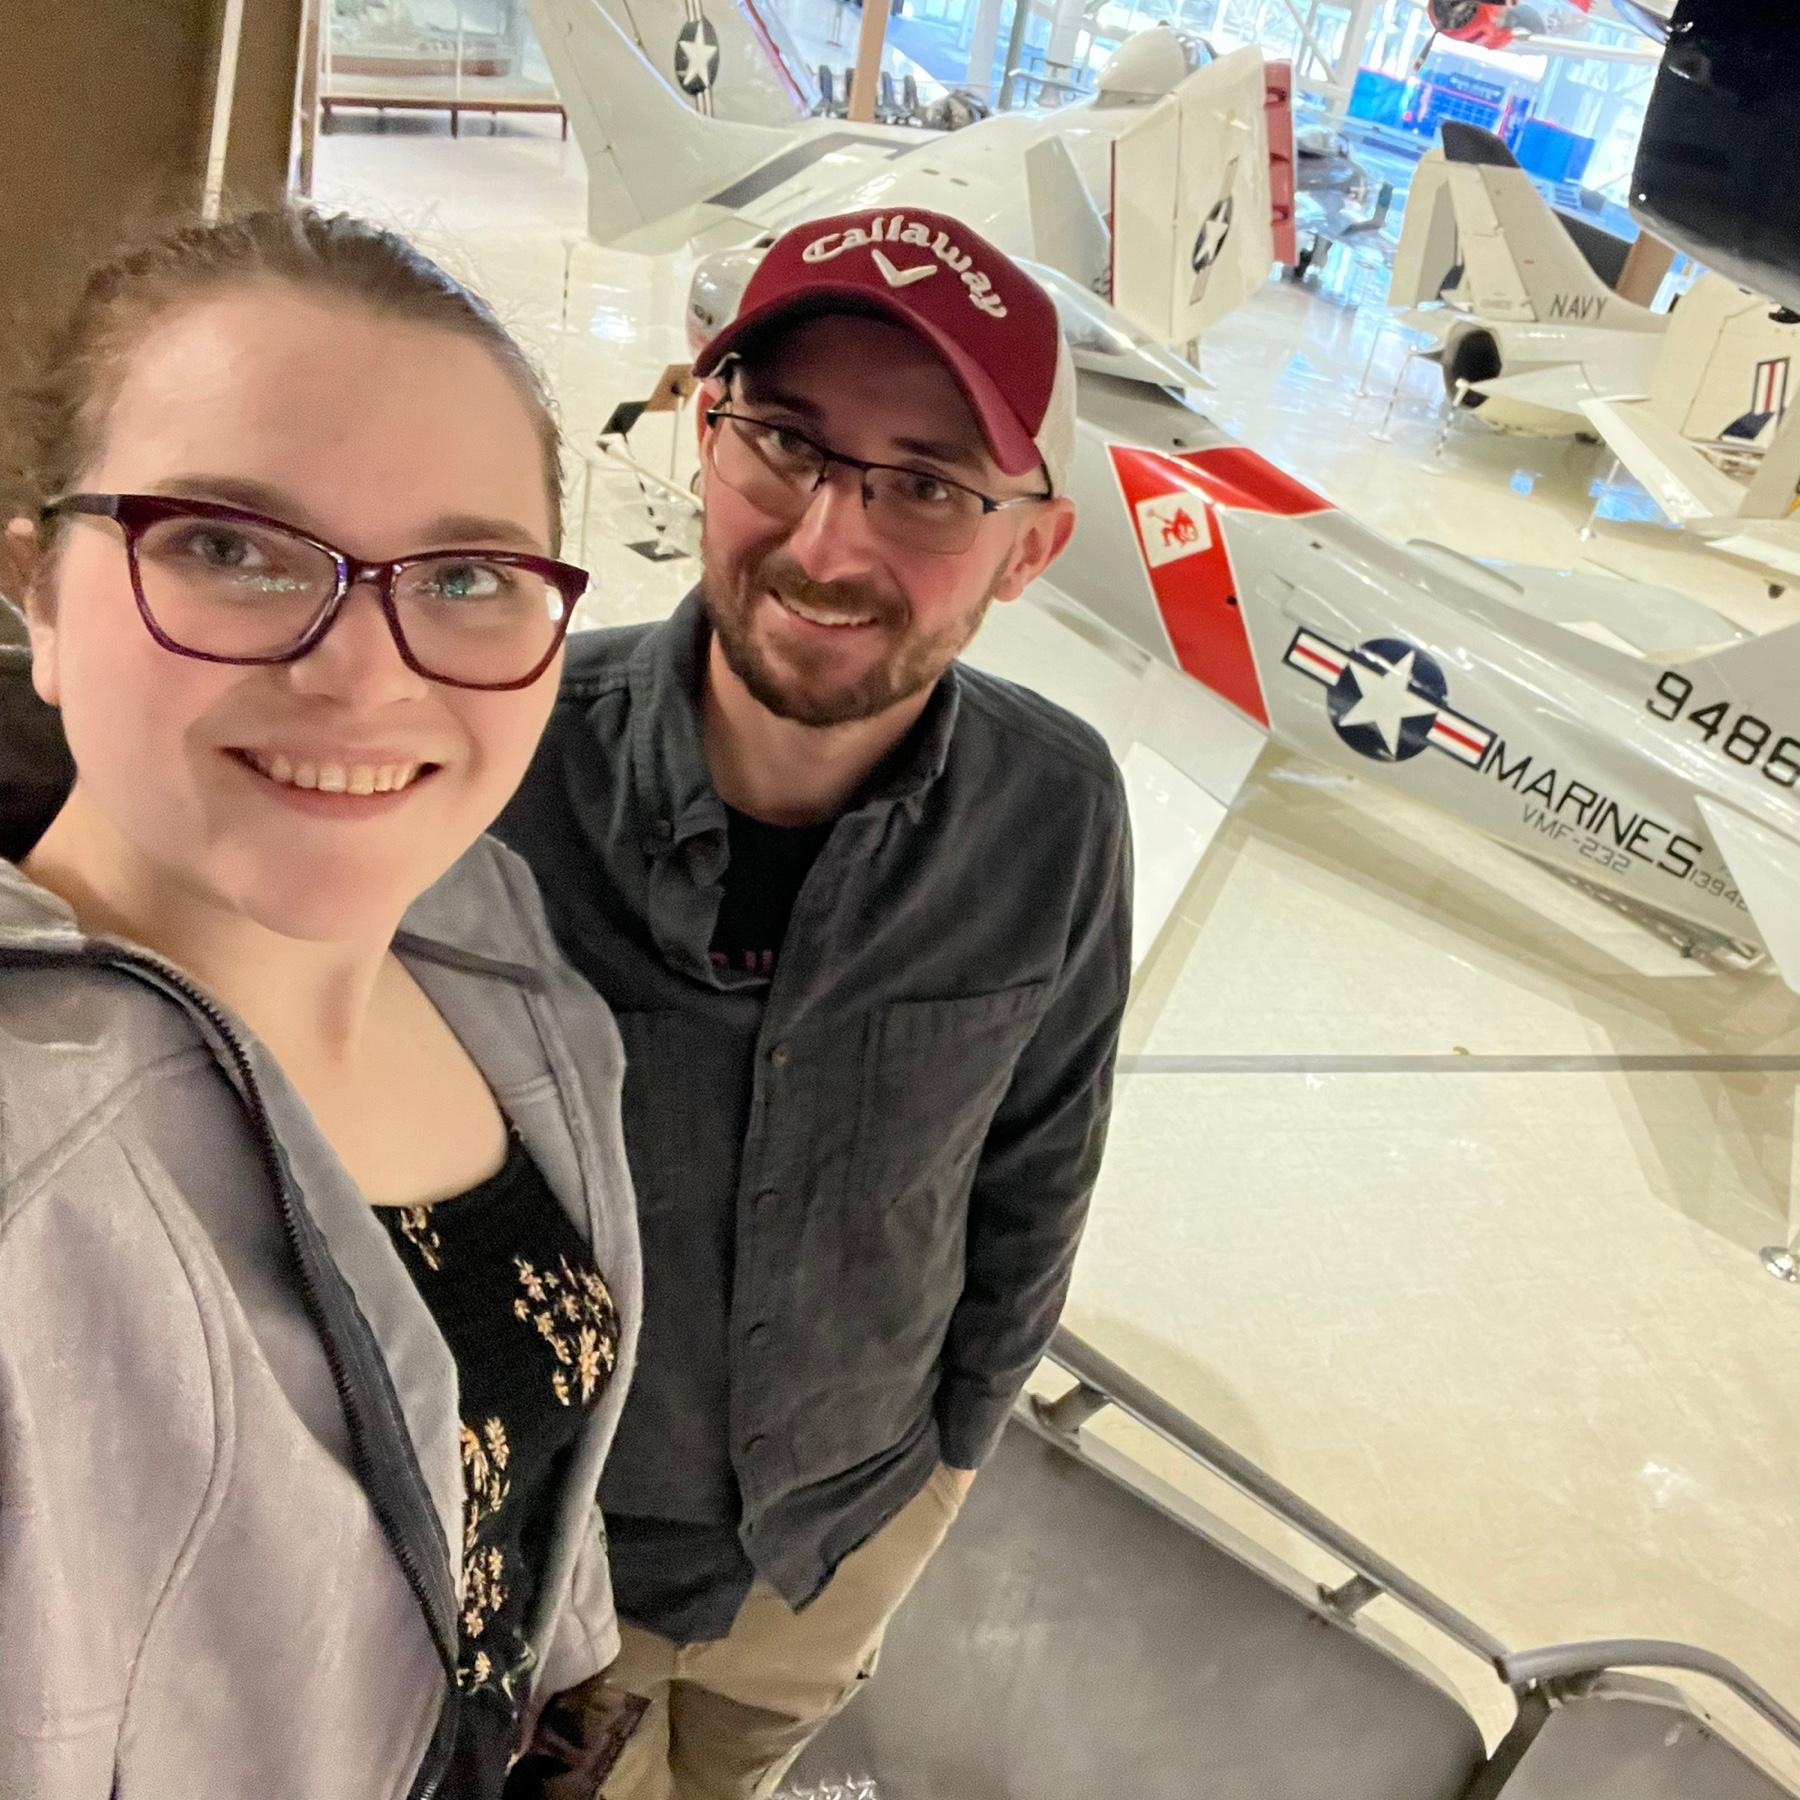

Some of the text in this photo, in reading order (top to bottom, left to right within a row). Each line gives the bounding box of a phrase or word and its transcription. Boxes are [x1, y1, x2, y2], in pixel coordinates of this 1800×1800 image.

[802, 214, 1007, 318] Callaway
[1548, 294, 1607, 319] NAVY
[1485, 741, 1703, 879] MARINES
[1522, 804, 1632, 874] VMF-232
